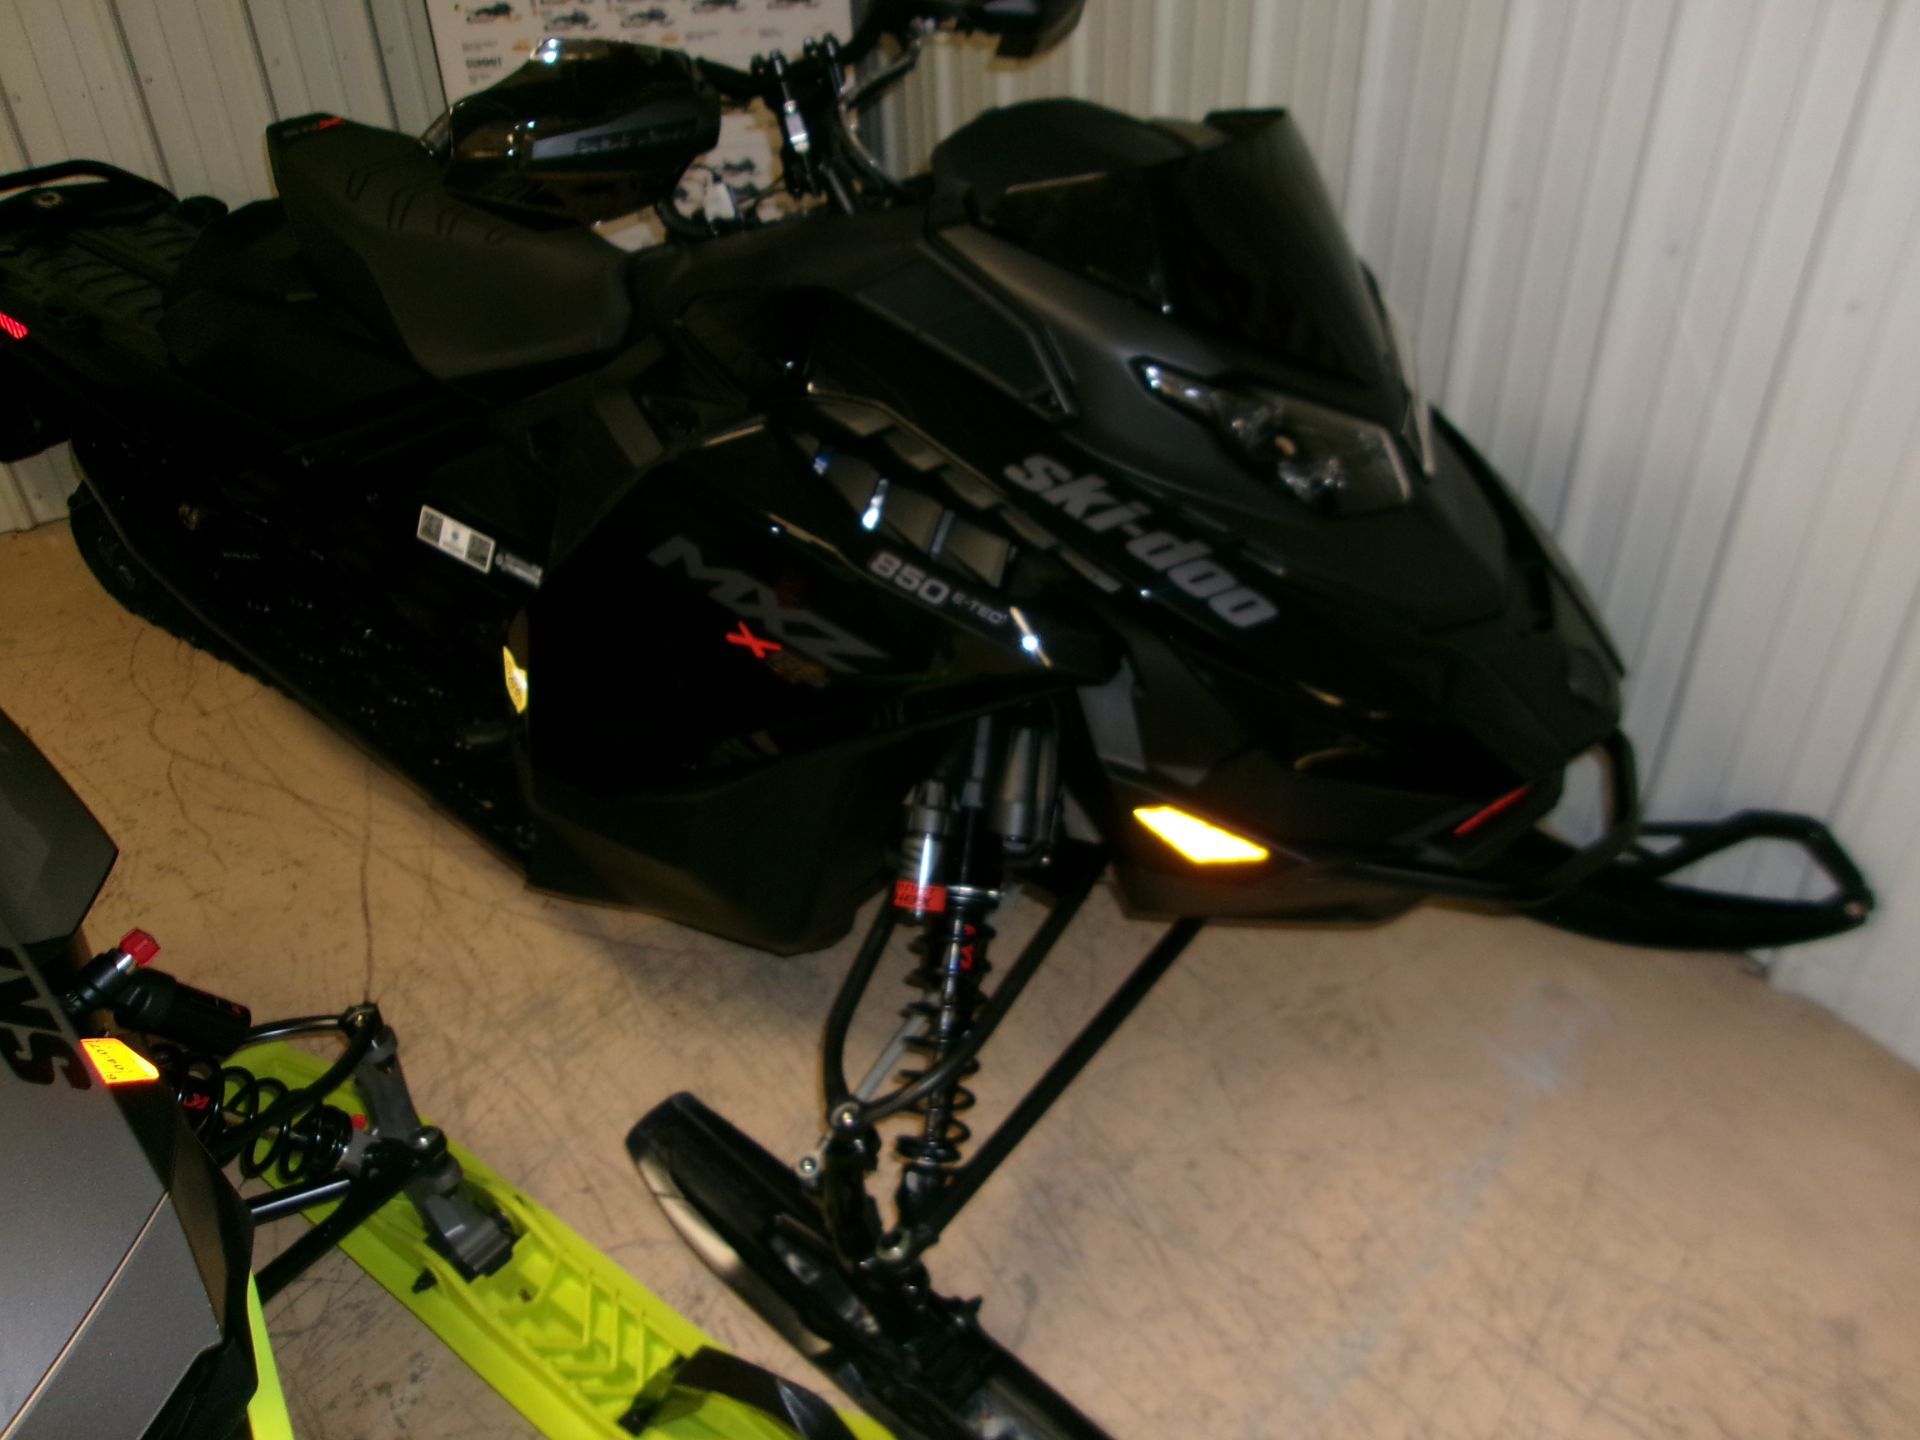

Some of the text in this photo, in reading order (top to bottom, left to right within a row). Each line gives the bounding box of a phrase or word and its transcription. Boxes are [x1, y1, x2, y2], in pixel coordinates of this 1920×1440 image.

[648, 534, 889, 675] MXZ
[867, 549, 950, 606] 850
[724, 618, 783, 659] X
